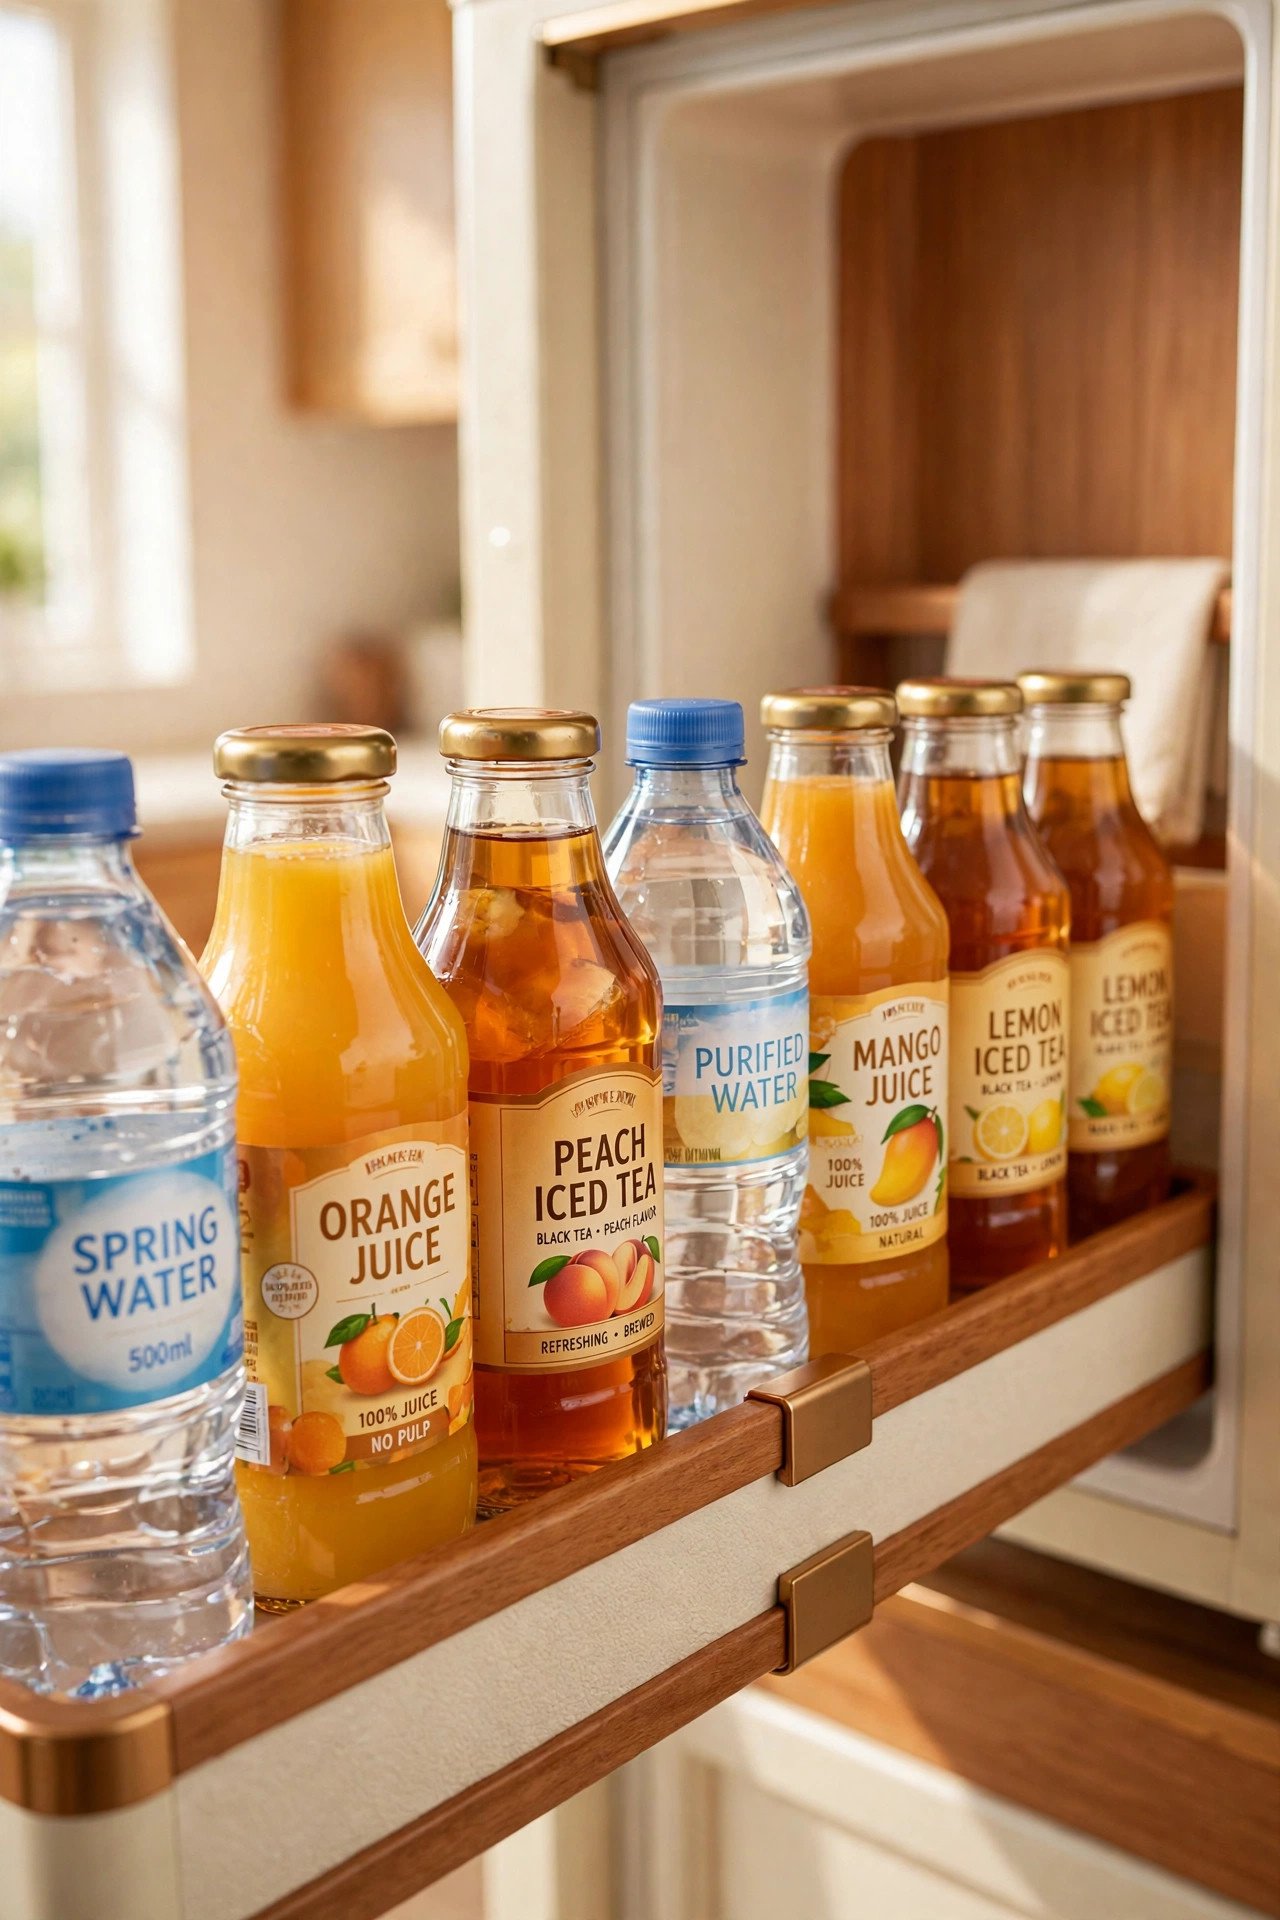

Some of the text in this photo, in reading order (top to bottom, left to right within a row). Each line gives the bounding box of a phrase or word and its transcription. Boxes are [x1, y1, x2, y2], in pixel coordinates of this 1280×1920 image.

[989, 998, 1062, 1039] LEMON
[696, 1033, 804, 1079] PURIFIED
[853, 1025, 941, 1071] MANGO
[976, 1044, 1030, 1076] ICED
[711, 1071, 797, 1113] WATER
[865, 1065, 932, 1106] JUICE
[982, 1082, 1012, 1096] BLACK
[555, 1123, 645, 1176] PEACH
[828, 1158, 863, 1171] 100%
[535, 1162, 656, 1221] ICED TEA
[825, 1173, 864, 1188] JUICE
[977, 1168, 1009, 1181] BLACK
[320, 1172, 455, 1241] ORANGE
[870, 1201, 928, 1228] 100% JUICE
[73, 1206, 218, 1276] SPRING
[537, 1230, 571, 1245] BLACK
[574, 1227, 593, 1241] TEA
[604, 1217, 631, 1236] PEACH
[879, 1227, 924, 1248] NATURAL
[350, 1225, 441, 1285] JUICE
[81, 1254, 217, 1321] WATER
[128, 1333, 193, 1373] 500ml
[541, 1312, 655, 1354] REFRESHING BREWED
[358, 1389, 438, 1428] 100% JUICE
[371, 1420, 431, 1454] NO PULP
